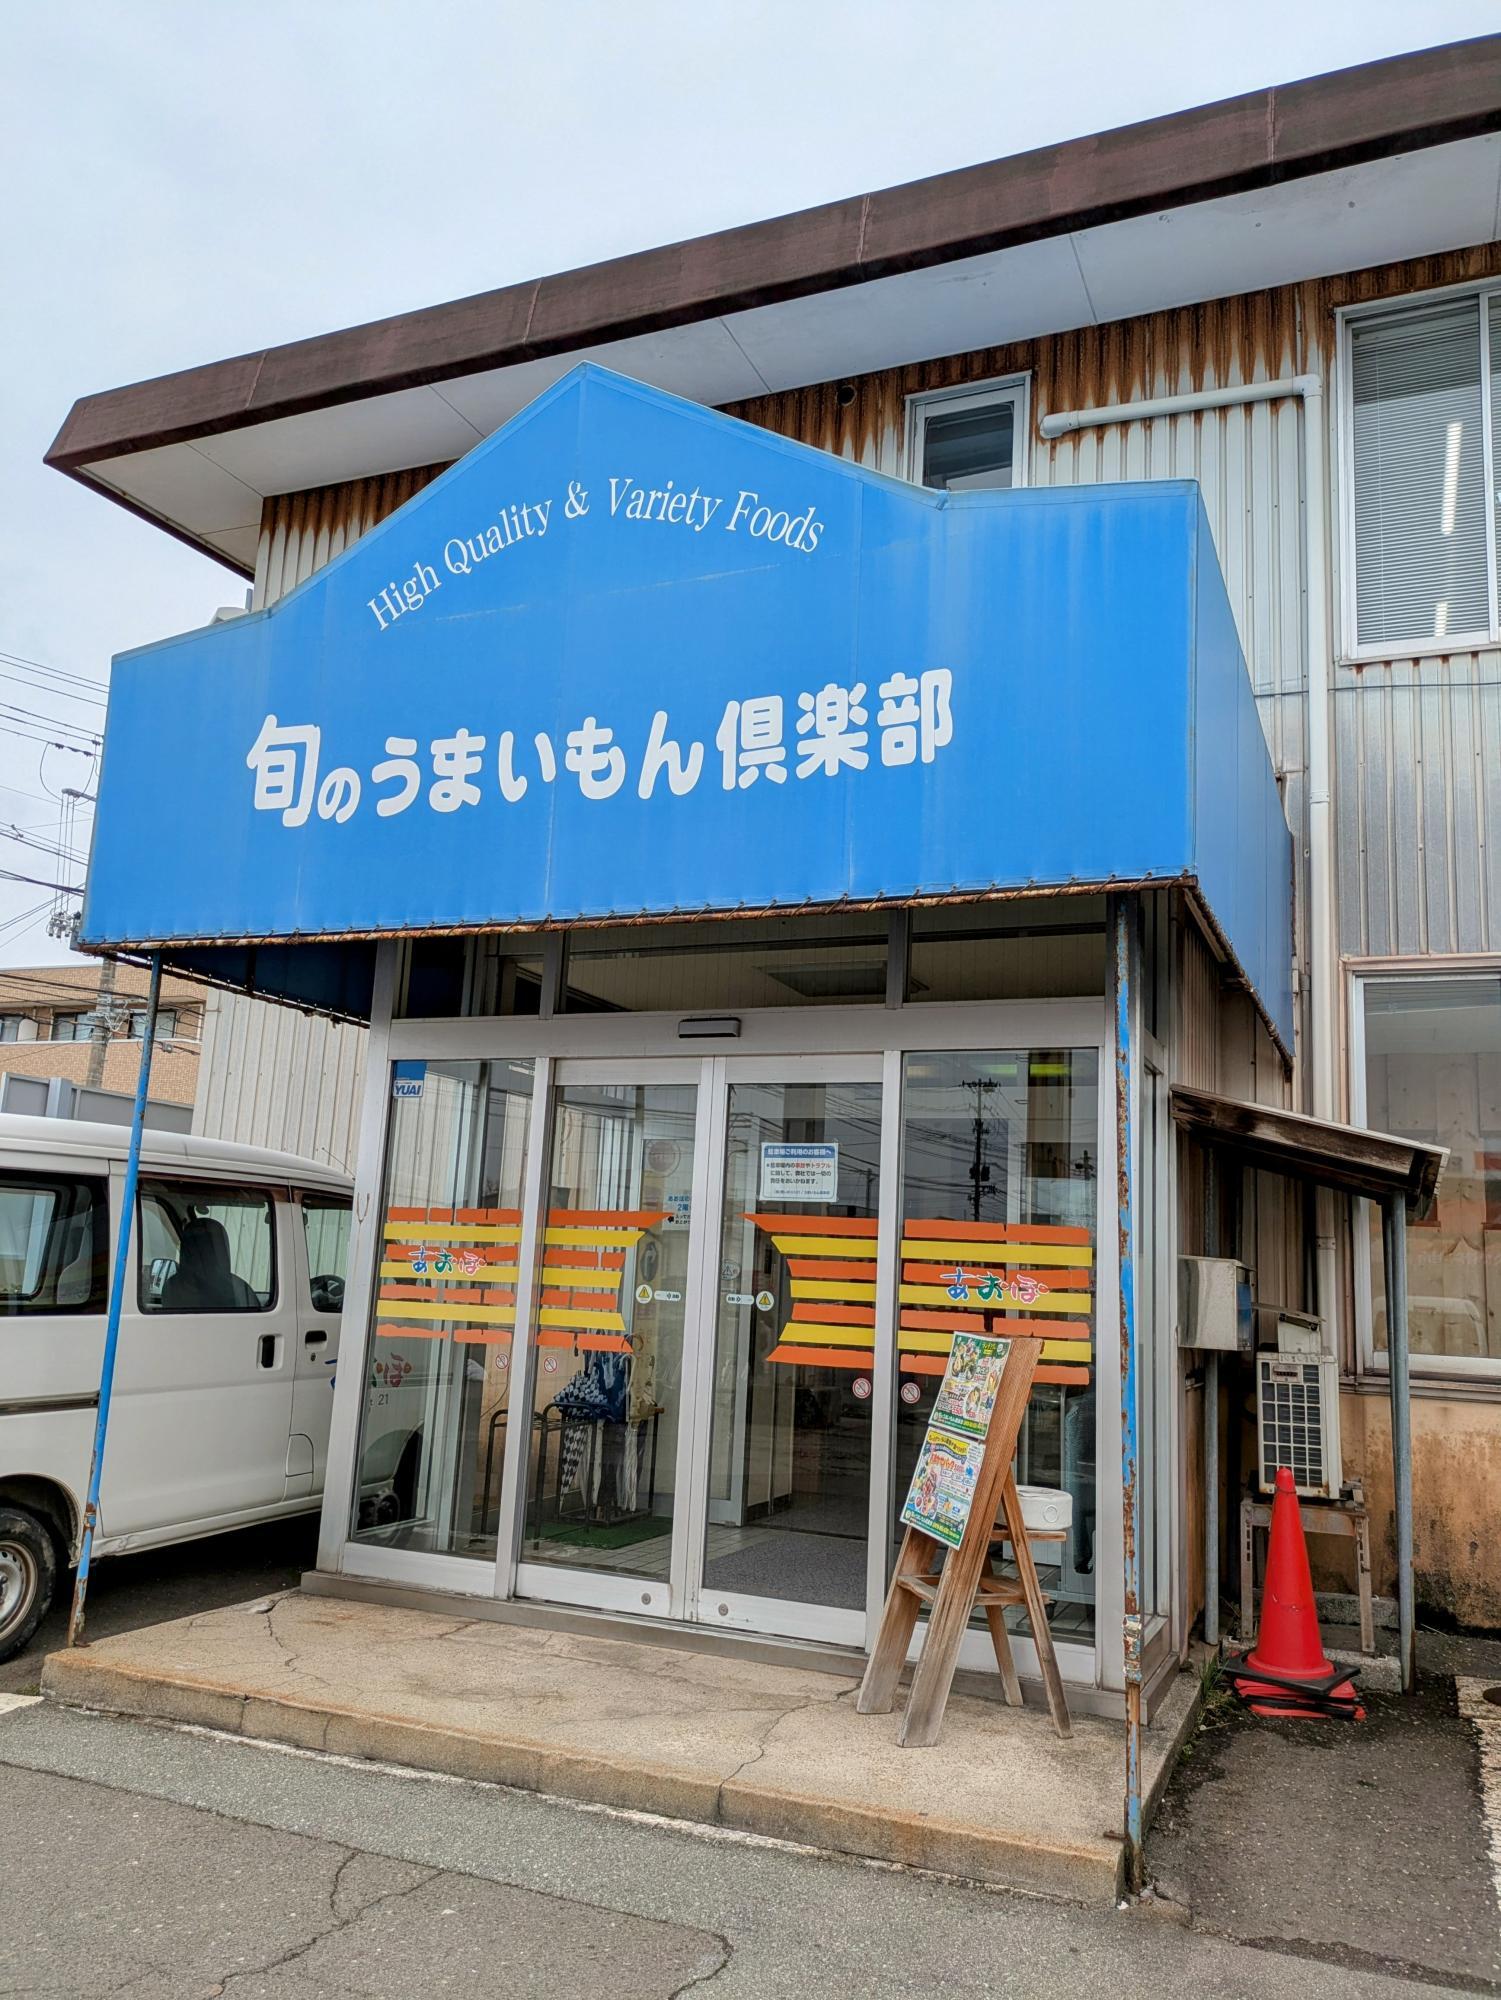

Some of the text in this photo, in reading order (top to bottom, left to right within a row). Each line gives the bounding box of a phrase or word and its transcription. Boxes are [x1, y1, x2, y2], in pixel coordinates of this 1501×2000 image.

[366, 477, 825, 631] High Quality & Variety Foods
[246, 668, 953, 828] 旬のうまいもん倶楽部
[395, 1085, 421, 1095] YUAI
[377, 1393, 390, 1406] 21
